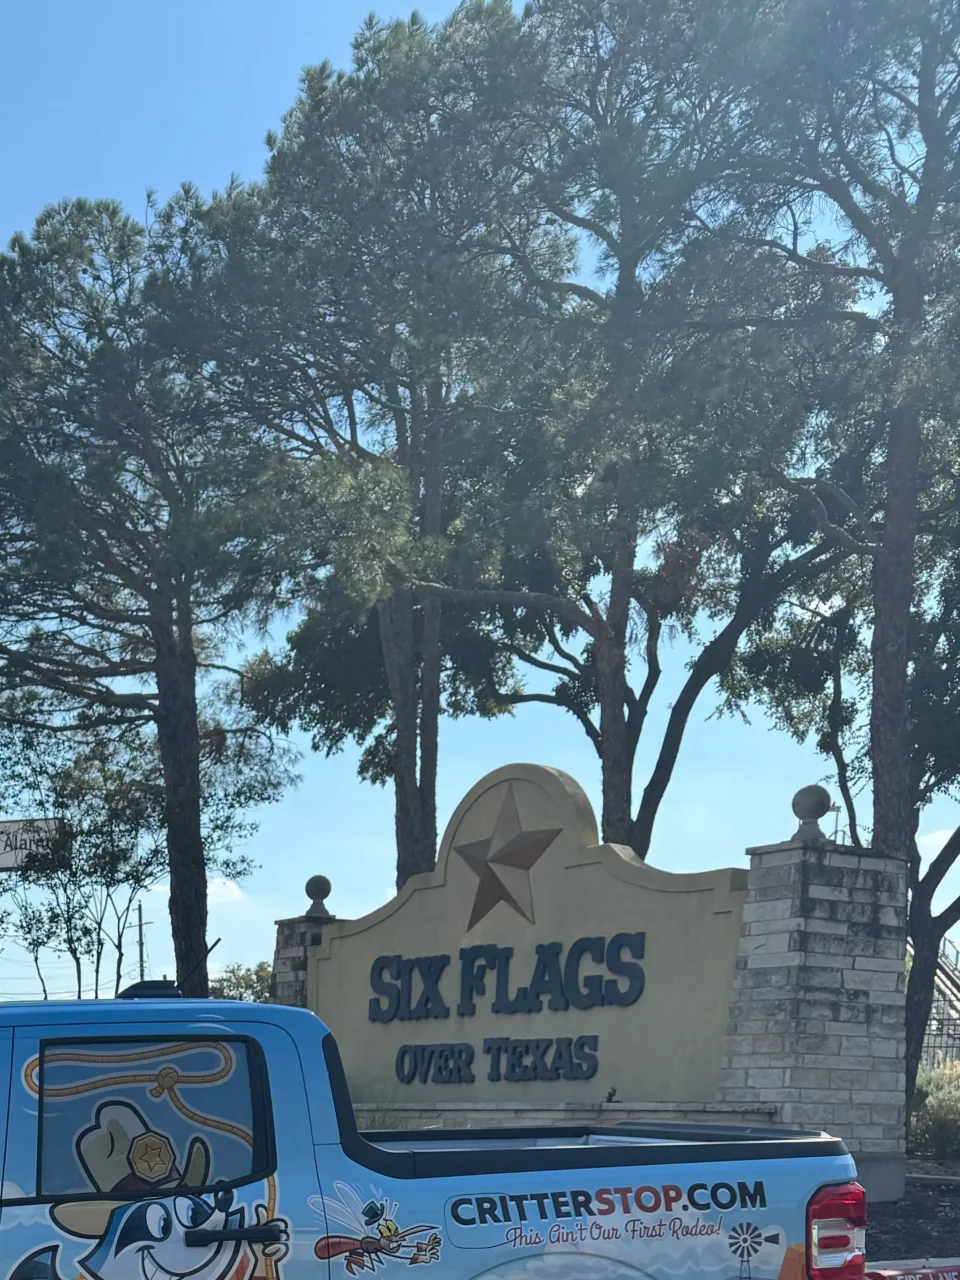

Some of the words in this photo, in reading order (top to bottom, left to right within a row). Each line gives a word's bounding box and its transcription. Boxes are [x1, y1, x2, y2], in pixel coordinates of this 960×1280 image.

[368, 954, 451, 1024] SIX
[456, 931, 647, 1017] FLAGS
[395, 1042, 476, 1085] OVER
[483, 1035, 599, 1082] TEXAS
[450, 1180, 768, 1226] CRITTERSTOP.COM
[505, 1223, 544, 1248] This
[548, 1222, 588, 1244] Ain't
[590, 1220, 622, 1241] Our
[625, 1218, 668, 1240] First
[668, 1215, 723, 1237] Rodeo!
